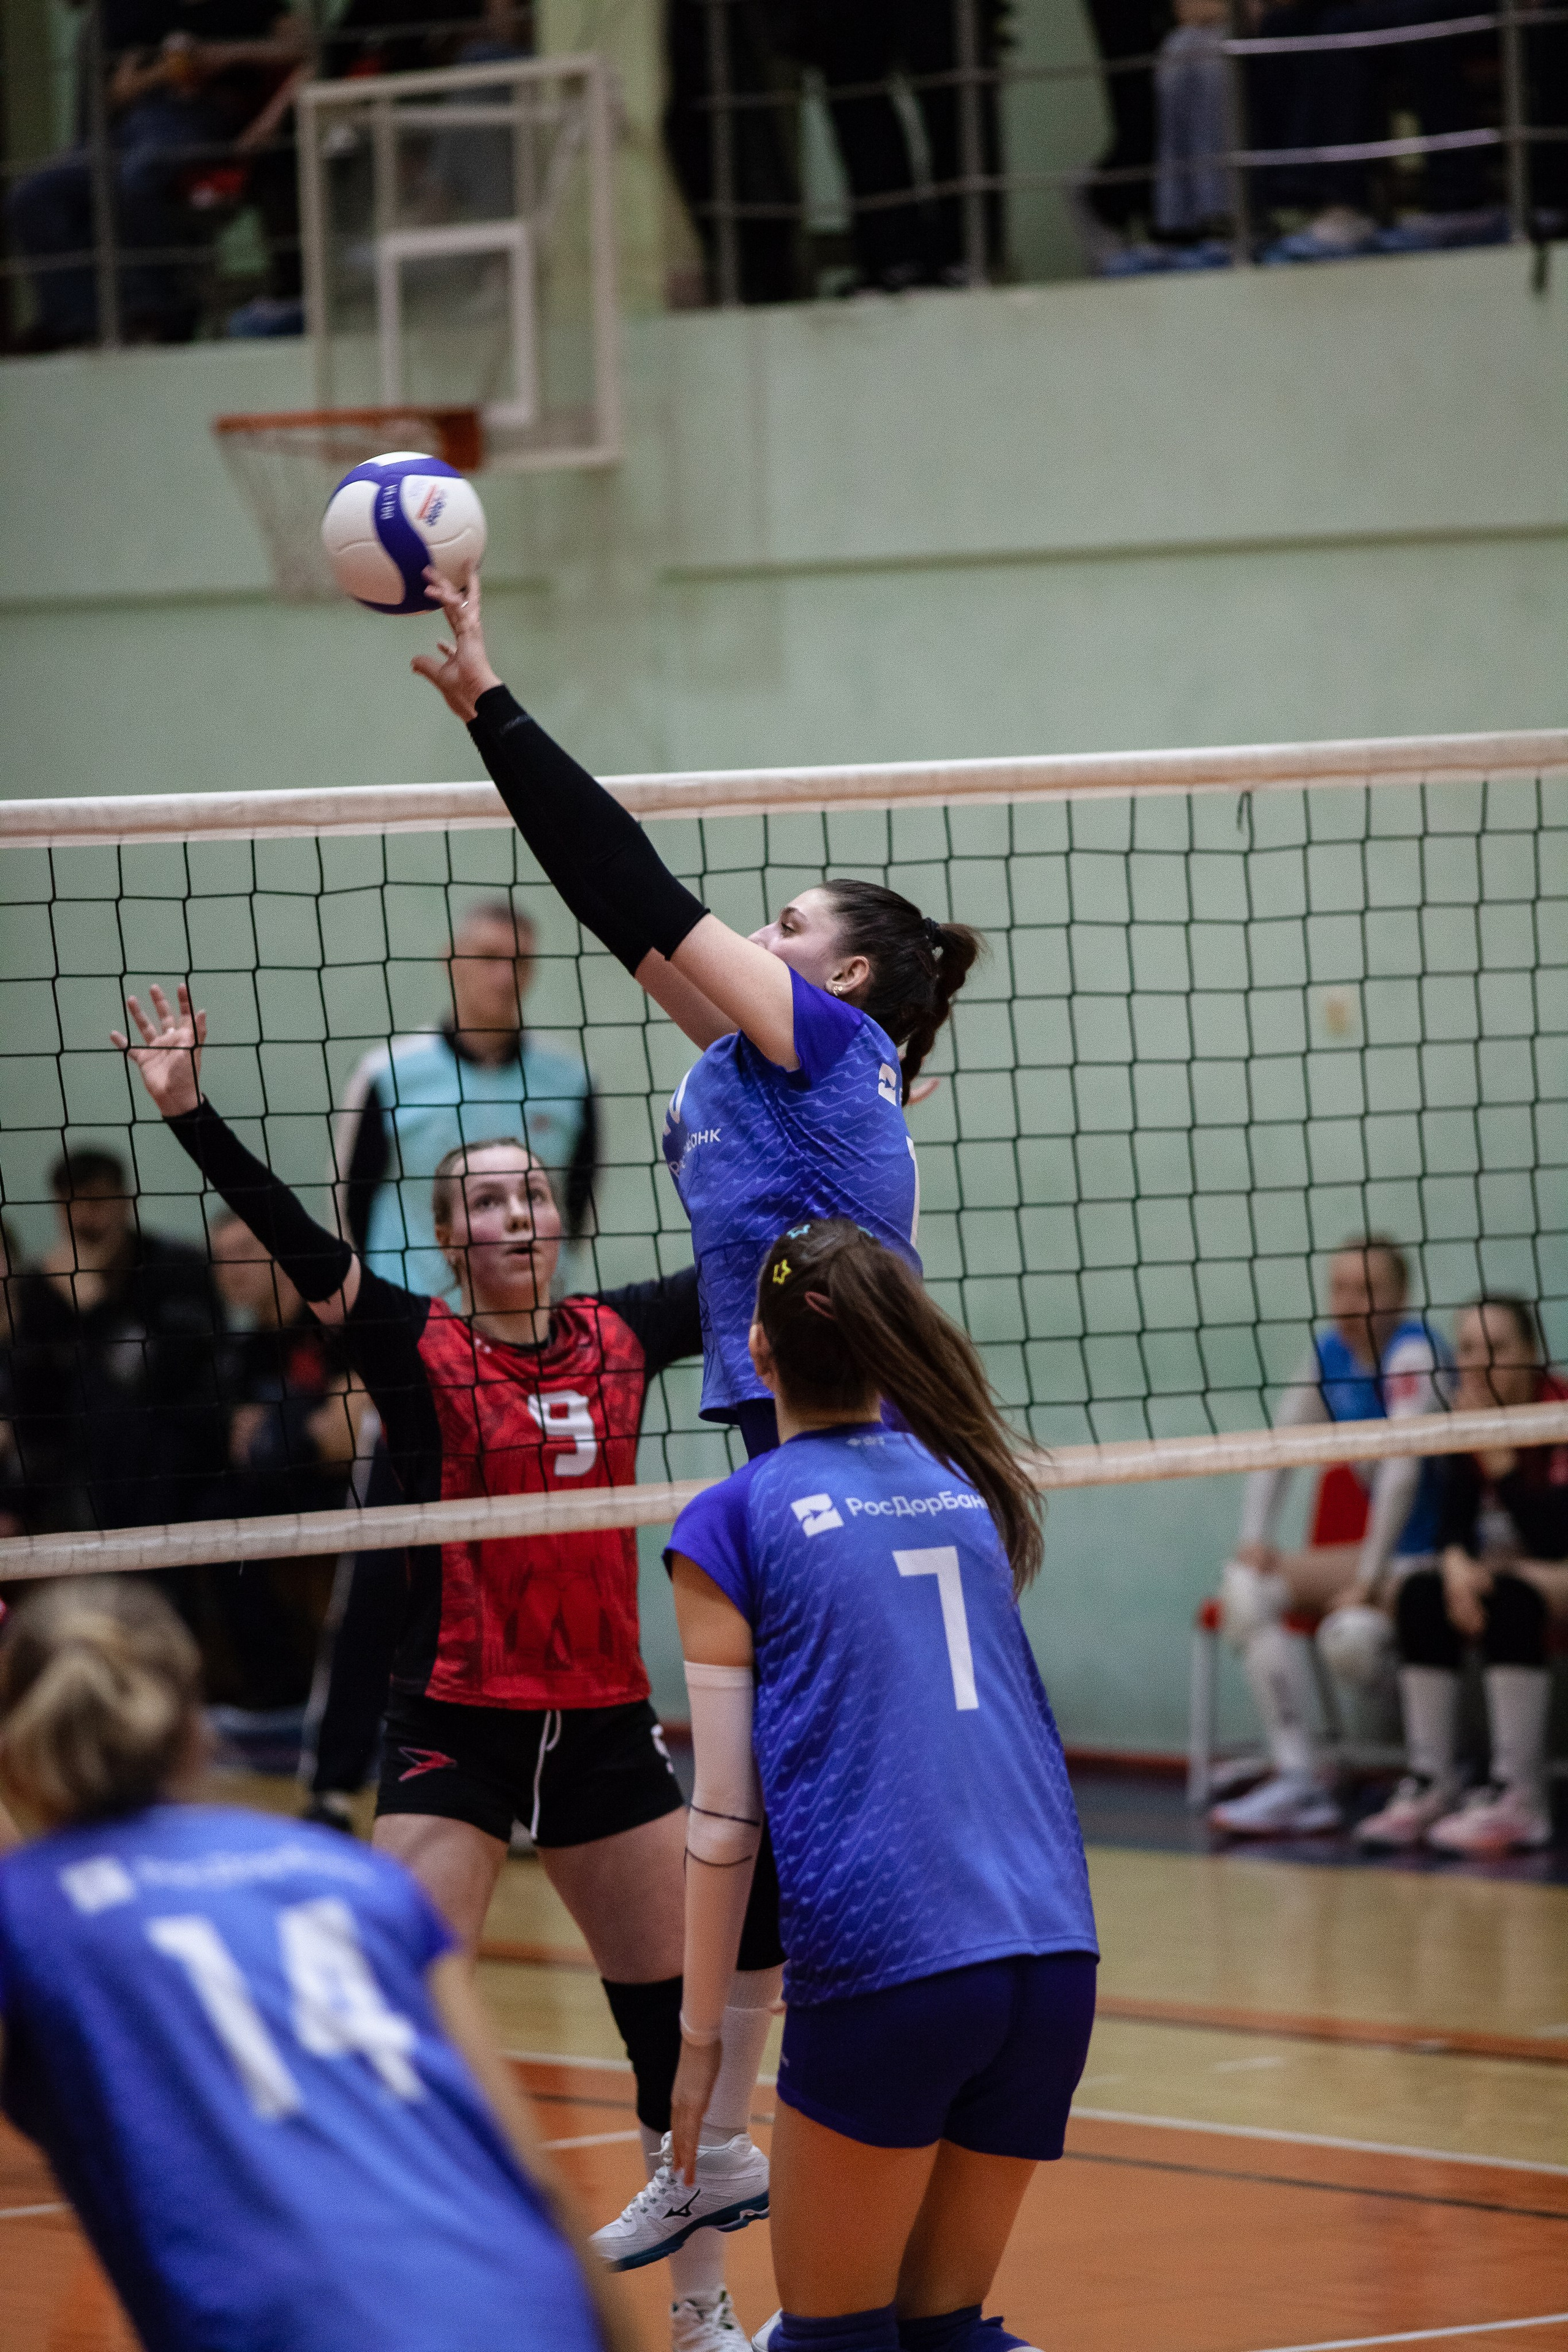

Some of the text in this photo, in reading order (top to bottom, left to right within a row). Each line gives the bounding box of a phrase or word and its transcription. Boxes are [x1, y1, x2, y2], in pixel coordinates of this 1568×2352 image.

[527, 1389, 598, 1477] 9
[845, 1490, 989, 1518] РосДорБан
[892, 1545, 979, 1711] 7
[144, 1897, 426, 2119] 14
